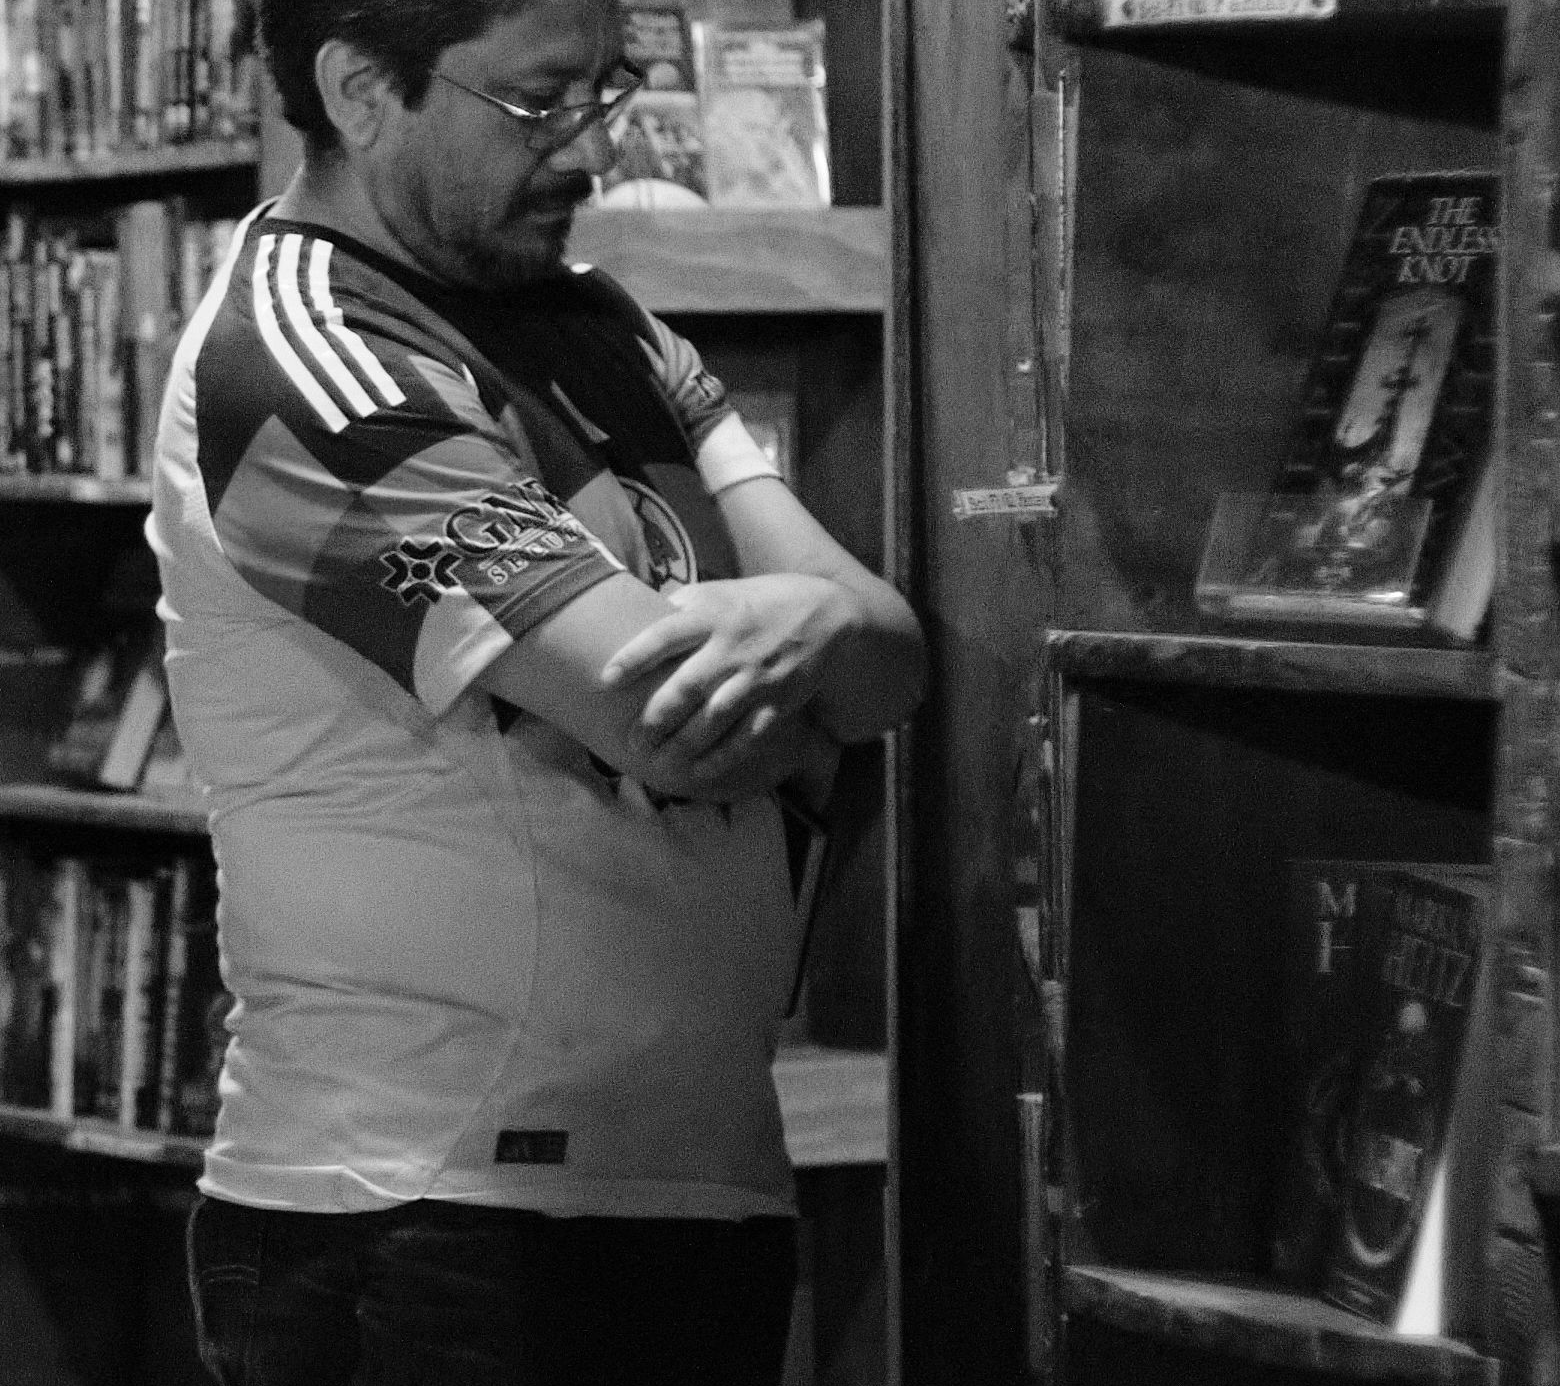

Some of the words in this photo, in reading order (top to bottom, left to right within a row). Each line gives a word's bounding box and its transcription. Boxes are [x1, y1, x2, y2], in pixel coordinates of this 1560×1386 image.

[1427, 196, 1482, 225] THE
[1389, 225, 1500, 254] ENDLESS
[1398, 255, 1478, 283] KNOT
